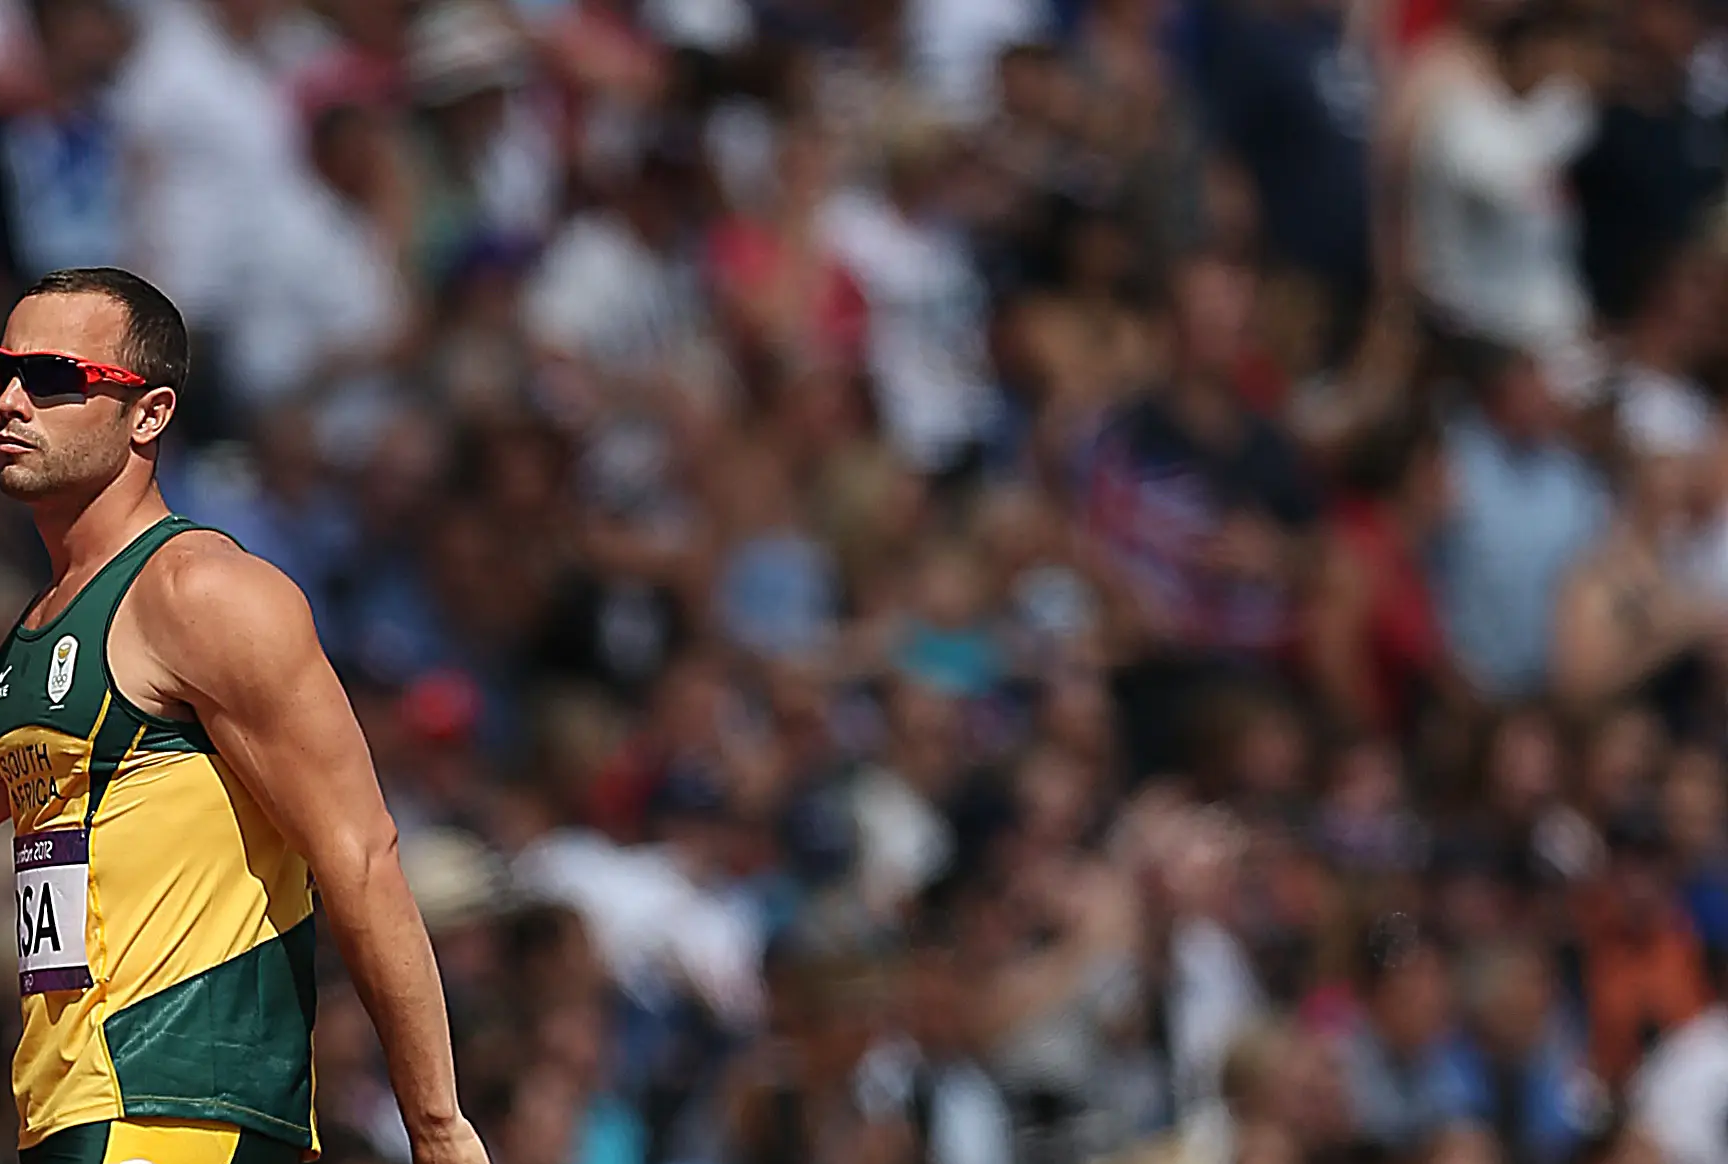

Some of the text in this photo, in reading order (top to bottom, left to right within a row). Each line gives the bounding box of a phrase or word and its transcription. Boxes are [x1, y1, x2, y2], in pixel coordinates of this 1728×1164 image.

[0, 743, 53, 782] SOUTH
[11, 776, 61, 811] AFRICA
[34, 840, 53, 861] 2012
